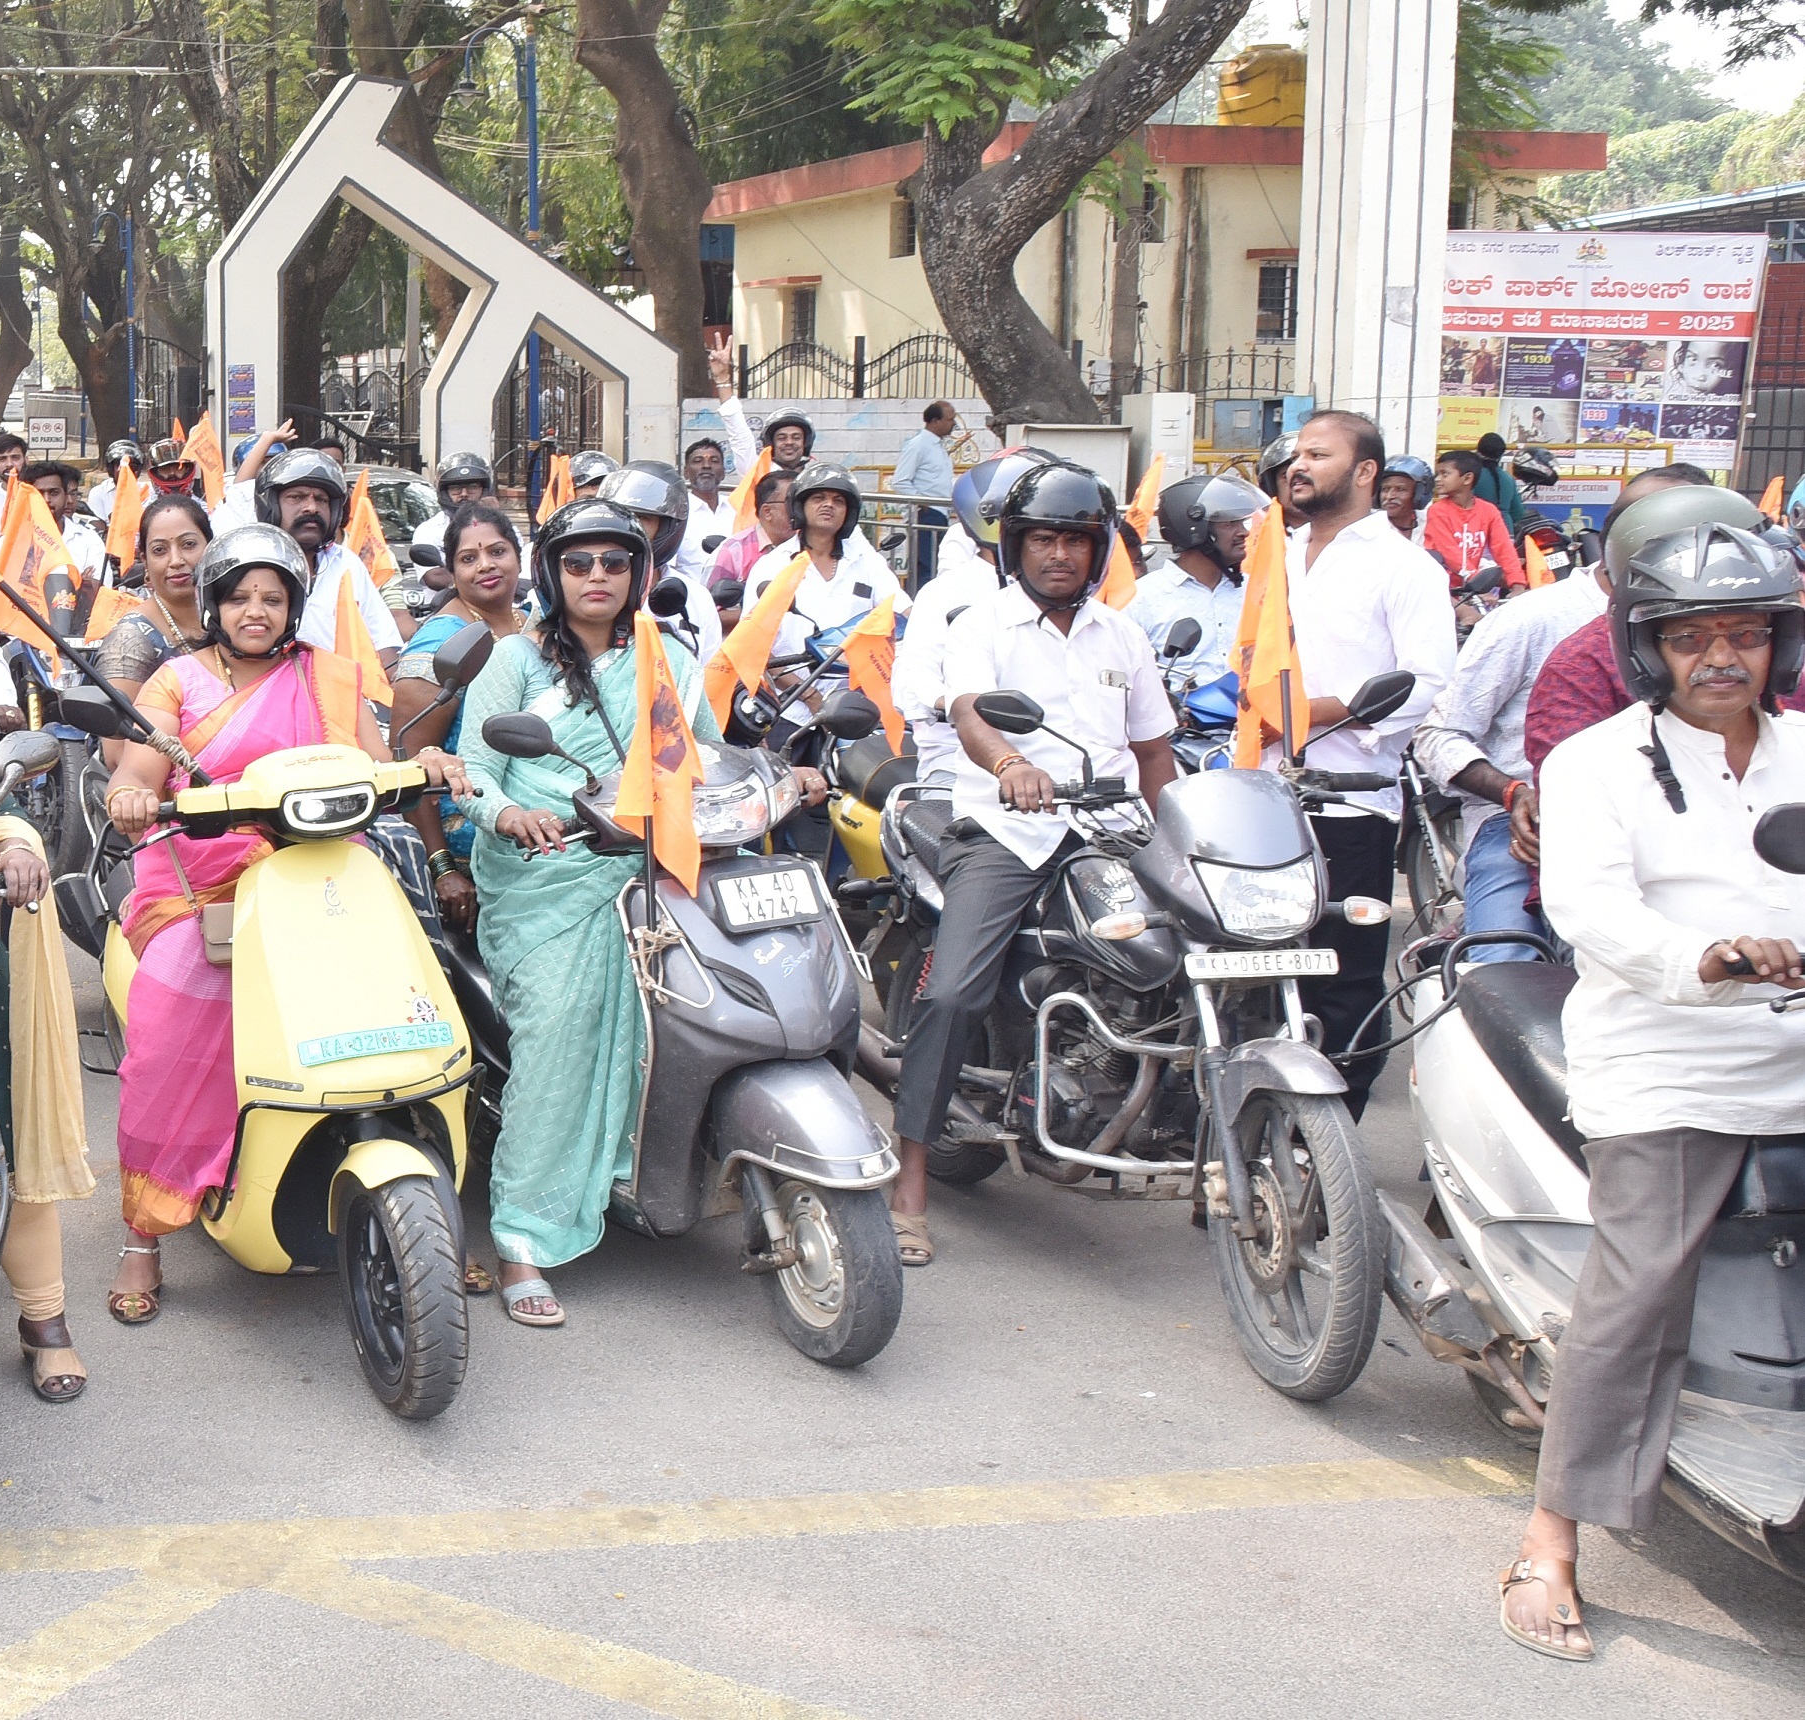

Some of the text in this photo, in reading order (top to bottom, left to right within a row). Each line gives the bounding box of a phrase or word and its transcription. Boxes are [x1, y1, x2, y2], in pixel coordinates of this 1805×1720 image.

[1443, 274, 1755, 300] ಲಕ್ ಪಾರ್ಕ್ ಪೊಲೀಸ್ ಠಾಣೆ
[1512, 312, 1542, 330] ತಡೆ
[1550, 312, 1649, 330] ಮಾಸಾಚರಣೆ
[1678, 315, 1736, 332] 2025
[1523, 355, 1552, 364] 1930
[1583, 409, 1608, 420] 1933
[1557, 484, 1581, 492] POLICE
[1583, 483, 1608, 492] STATION
[734, 871, 794, 899] KA 40
[326, 906, 348, 917] OLA
[743, 895, 800, 922] X4742
[1294, 953, 1334, 972] 8071
[320, 1038, 344, 1058] KA
[406, 1025, 451, 1047] 2563
